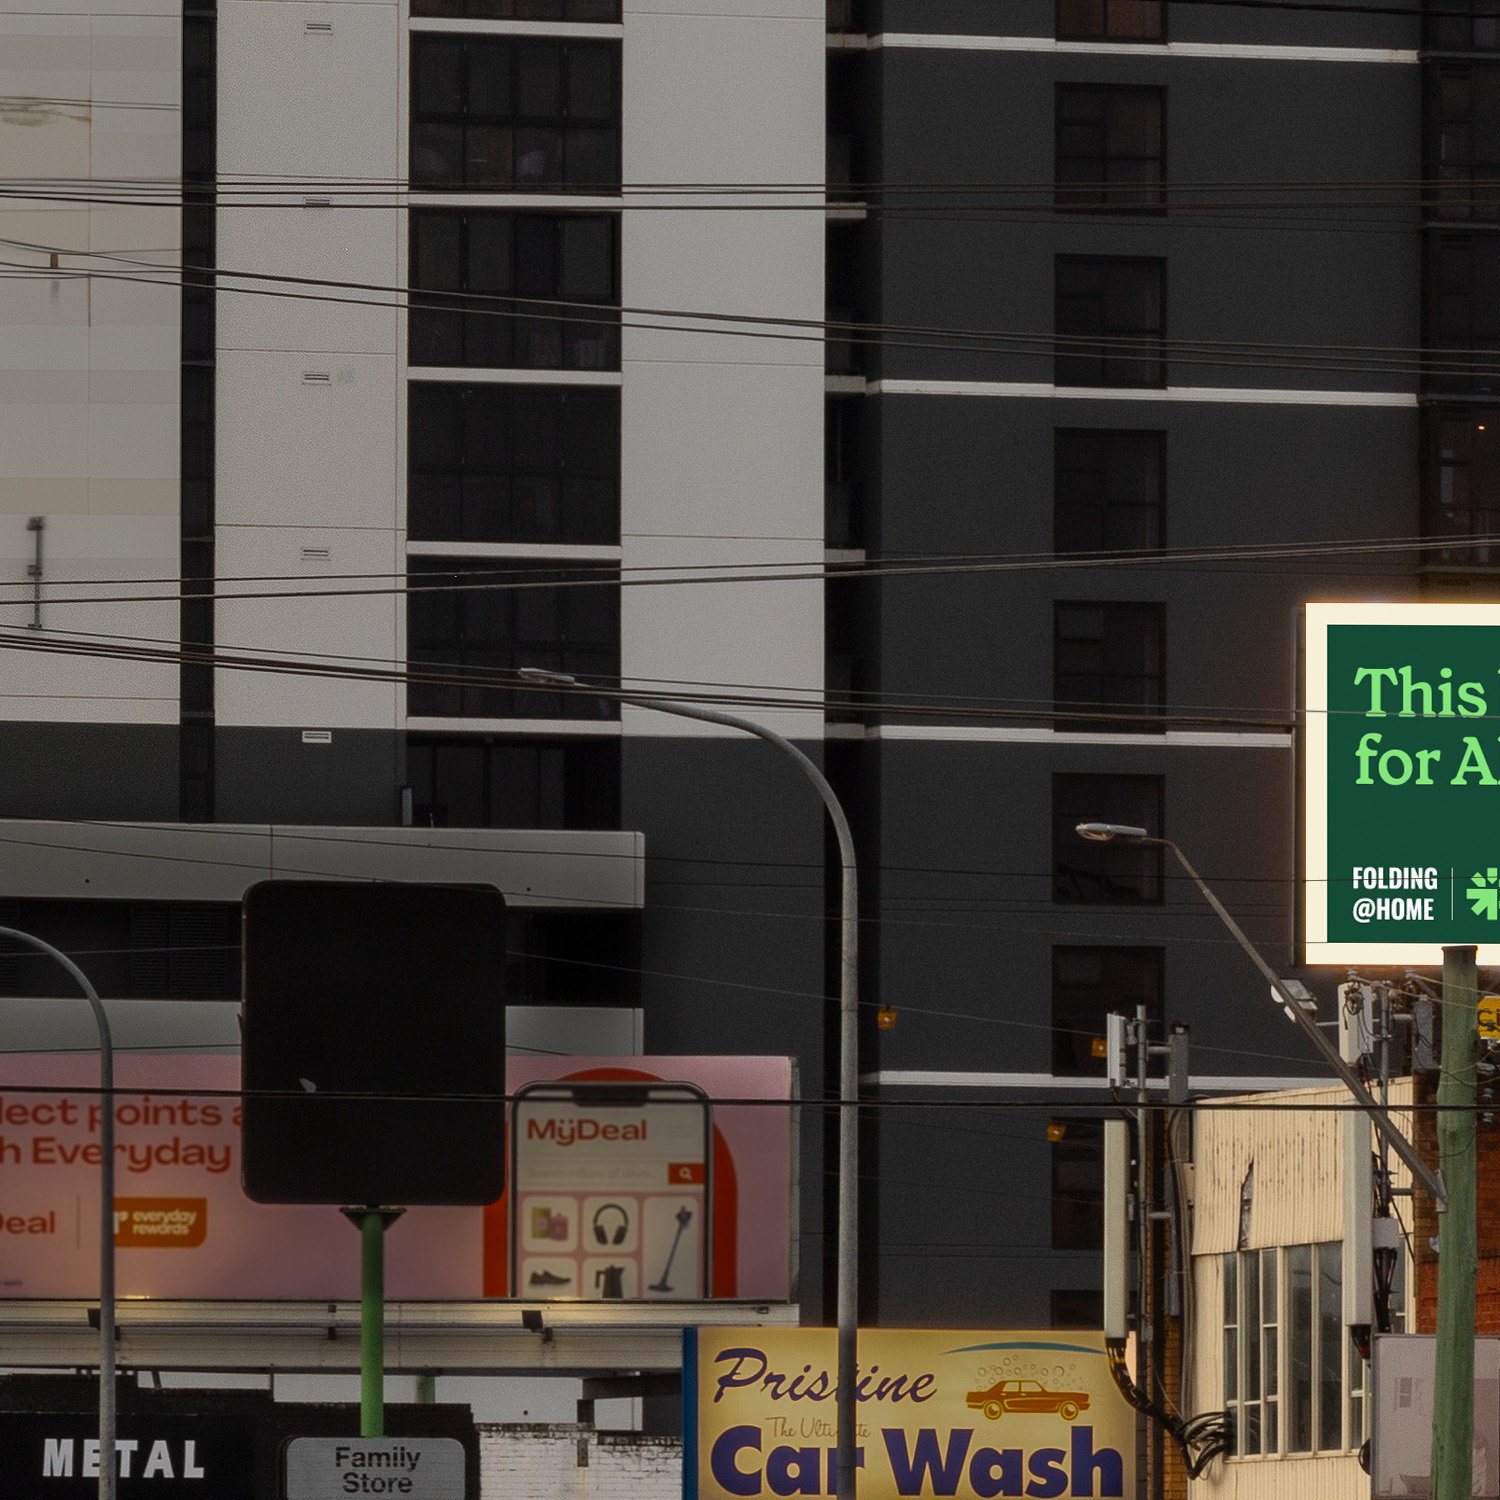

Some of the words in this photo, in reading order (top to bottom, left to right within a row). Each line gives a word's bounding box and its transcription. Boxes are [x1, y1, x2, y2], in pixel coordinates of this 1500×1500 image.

[1354, 665, 1487, 718] This
[1355, 732, 1441, 785] for
[1352, 866, 1438, 890] FOLDING
[1352, 897, 1435, 923] @HOME
[0, 1210, 55, 1234] eal
[132, 1208, 198, 1226] everyday
[765, 1416, 796, 1439] The
[799, 1415, 872, 1441] Ultite
[42, 1438, 205, 1479] METAL
[335, 1445, 421, 1473] Family
[710, 1424, 866, 1497] Car
[881, 1425, 1124, 1499] Wash
[342, 1471, 414, 1494] Store
